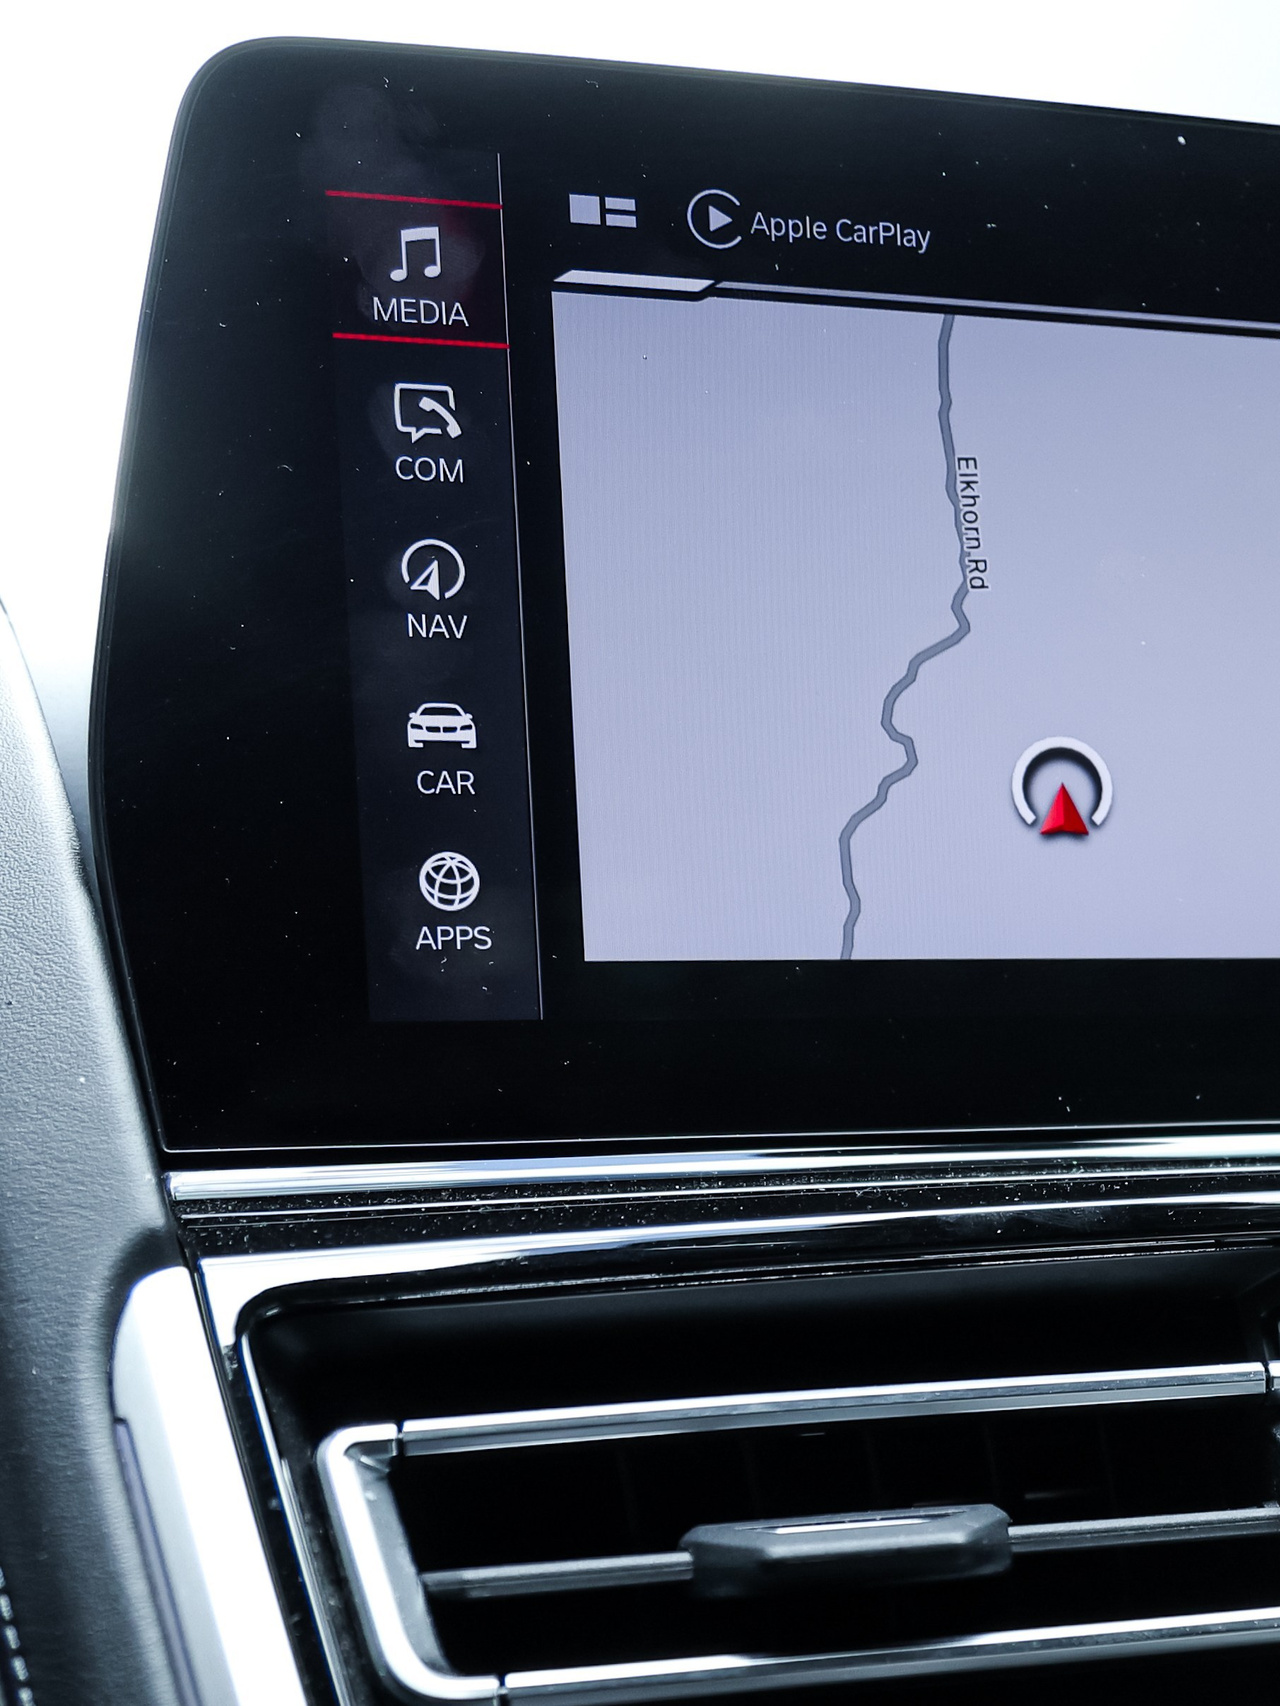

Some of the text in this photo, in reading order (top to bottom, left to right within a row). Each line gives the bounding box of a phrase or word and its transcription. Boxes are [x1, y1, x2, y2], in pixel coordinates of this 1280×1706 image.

[751, 210, 931, 253] Apple CarPlay
[372, 297, 469, 327] MEDIA
[395, 456, 464, 483] COM
[957, 457, 989, 590] Elkhorn Rd
[406, 614, 467, 639] NAV
[417, 770, 475, 795] CAR
[415, 926, 492, 950] APPS
